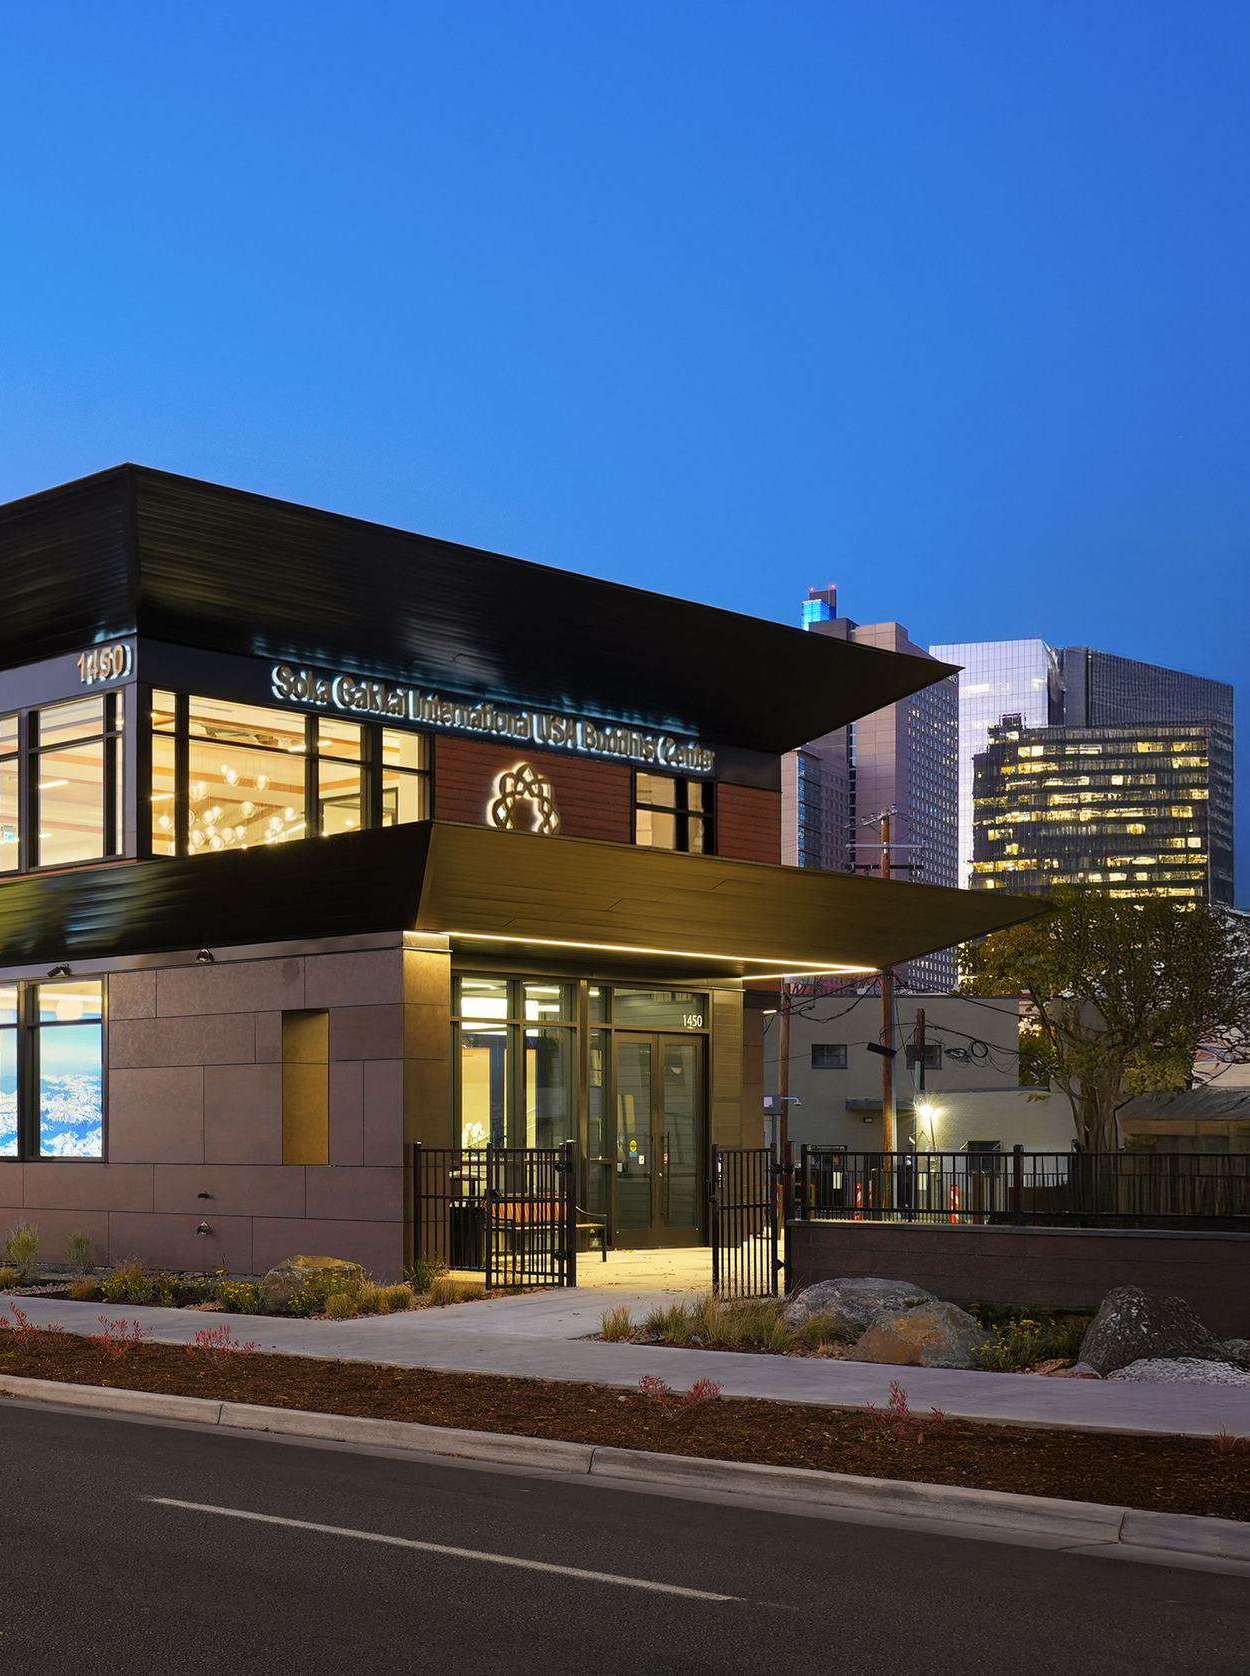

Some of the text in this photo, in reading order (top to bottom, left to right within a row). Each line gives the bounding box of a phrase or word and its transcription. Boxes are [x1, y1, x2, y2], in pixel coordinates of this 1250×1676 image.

[77, 644, 129, 683] 1450
[273, 665, 715, 771] Soka Gakkai International USA Buddhist Center
[683, 1014, 703, 1027] 1450
